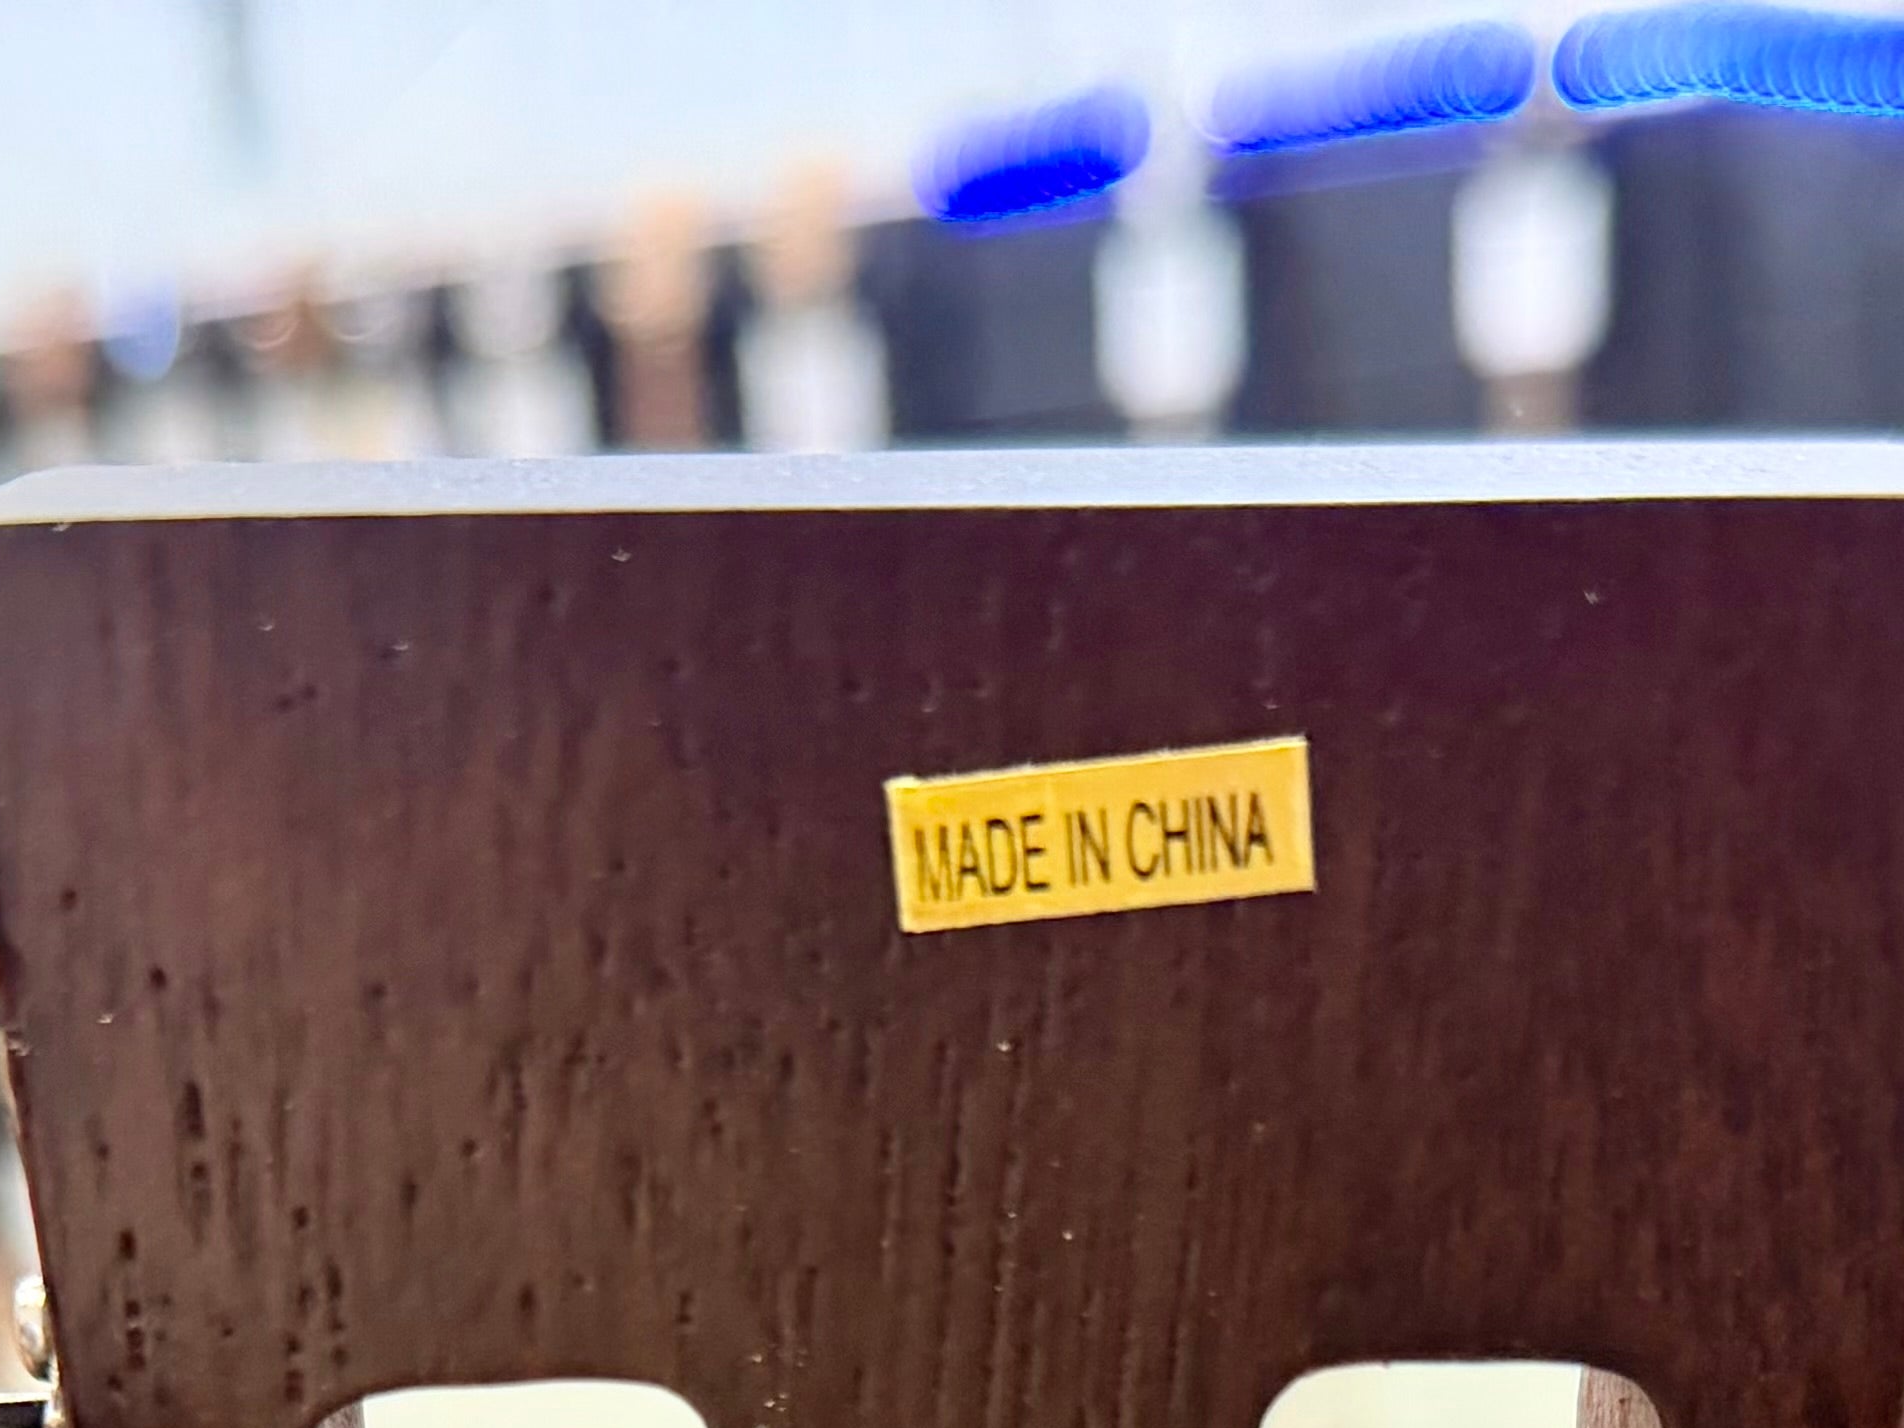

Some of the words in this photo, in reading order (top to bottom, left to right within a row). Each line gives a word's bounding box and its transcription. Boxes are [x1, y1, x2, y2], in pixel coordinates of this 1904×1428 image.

[913, 814, 1050, 903] MADE
[1064, 807, 1111, 887] IN
[1125, 790, 1275, 881] CHINA
